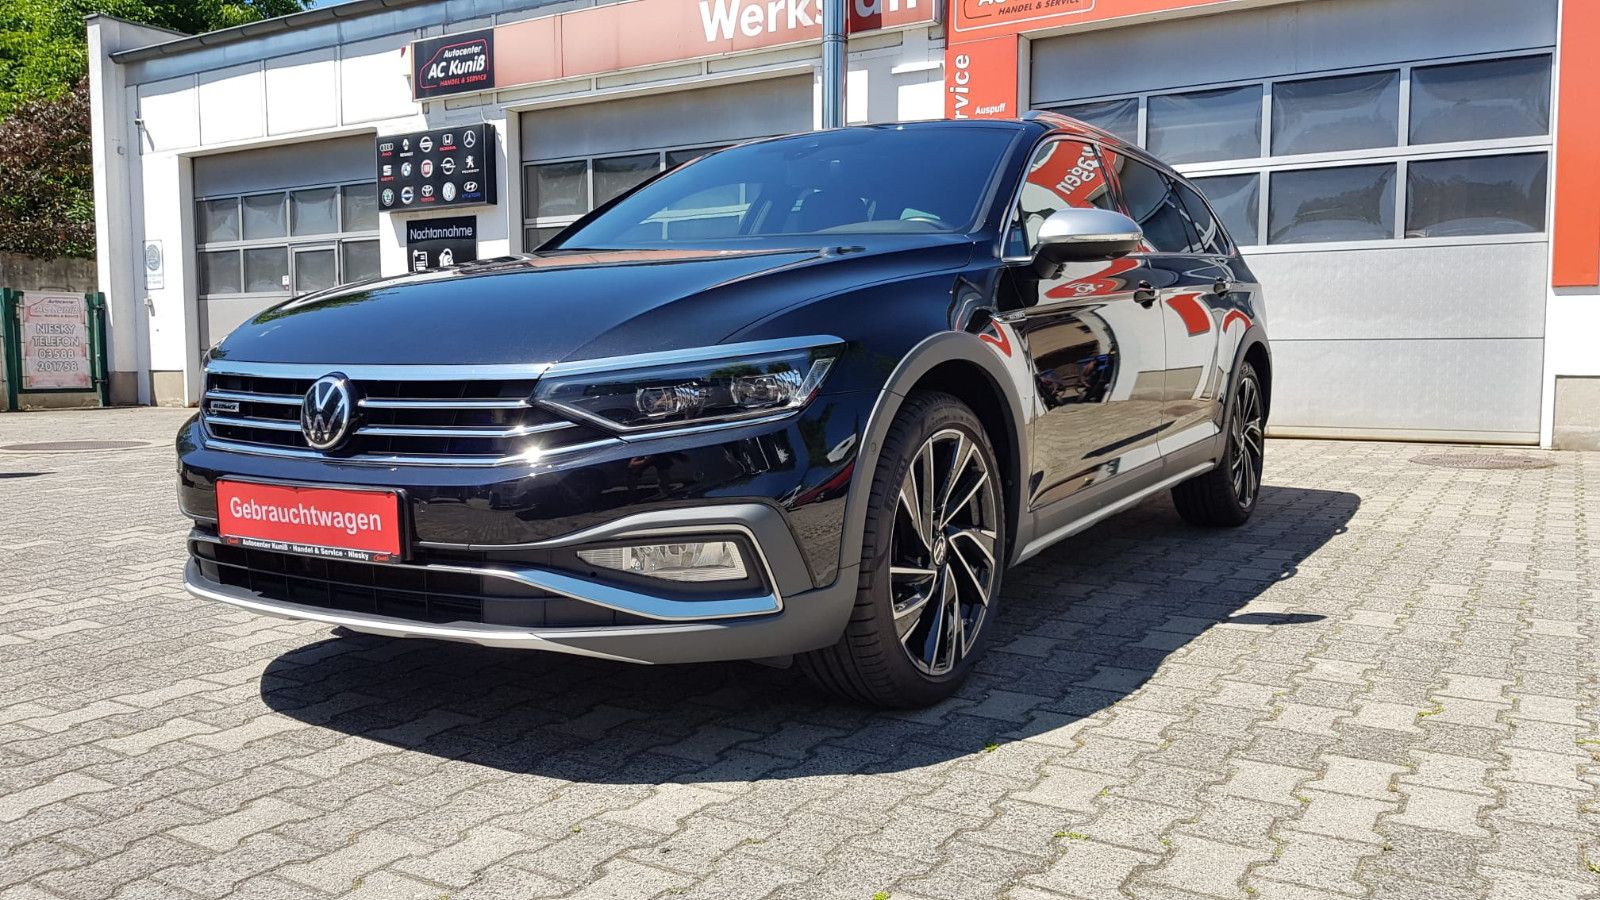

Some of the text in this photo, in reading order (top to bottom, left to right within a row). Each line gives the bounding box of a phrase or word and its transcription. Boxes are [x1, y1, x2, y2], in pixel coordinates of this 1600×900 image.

[998, 3, 1032, 15] HANDEL
[443, 45, 482, 59] Autocenter
[428, 55, 486, 79] AC Kuniß
[949, 54, 969, 120] rvice
[975, 102, 1006, 116] Auspuff
[410, 224, 473, 240] Nachtannahme
[35, 323, 76, 335] NIESKY
[32, 335, 80, 347] TELEFON
[38, 348, 75, 359] 03588
[37, 360, 79, 373] 201758
[229, 496, 382, 535] Gebrauchtwagen
[242, 538, 271, 549] Autocenter
[292, 544, 314, 554] Handel
[320, 547, 343, 557] Service
[348, 551, 369, 561] Niesky
